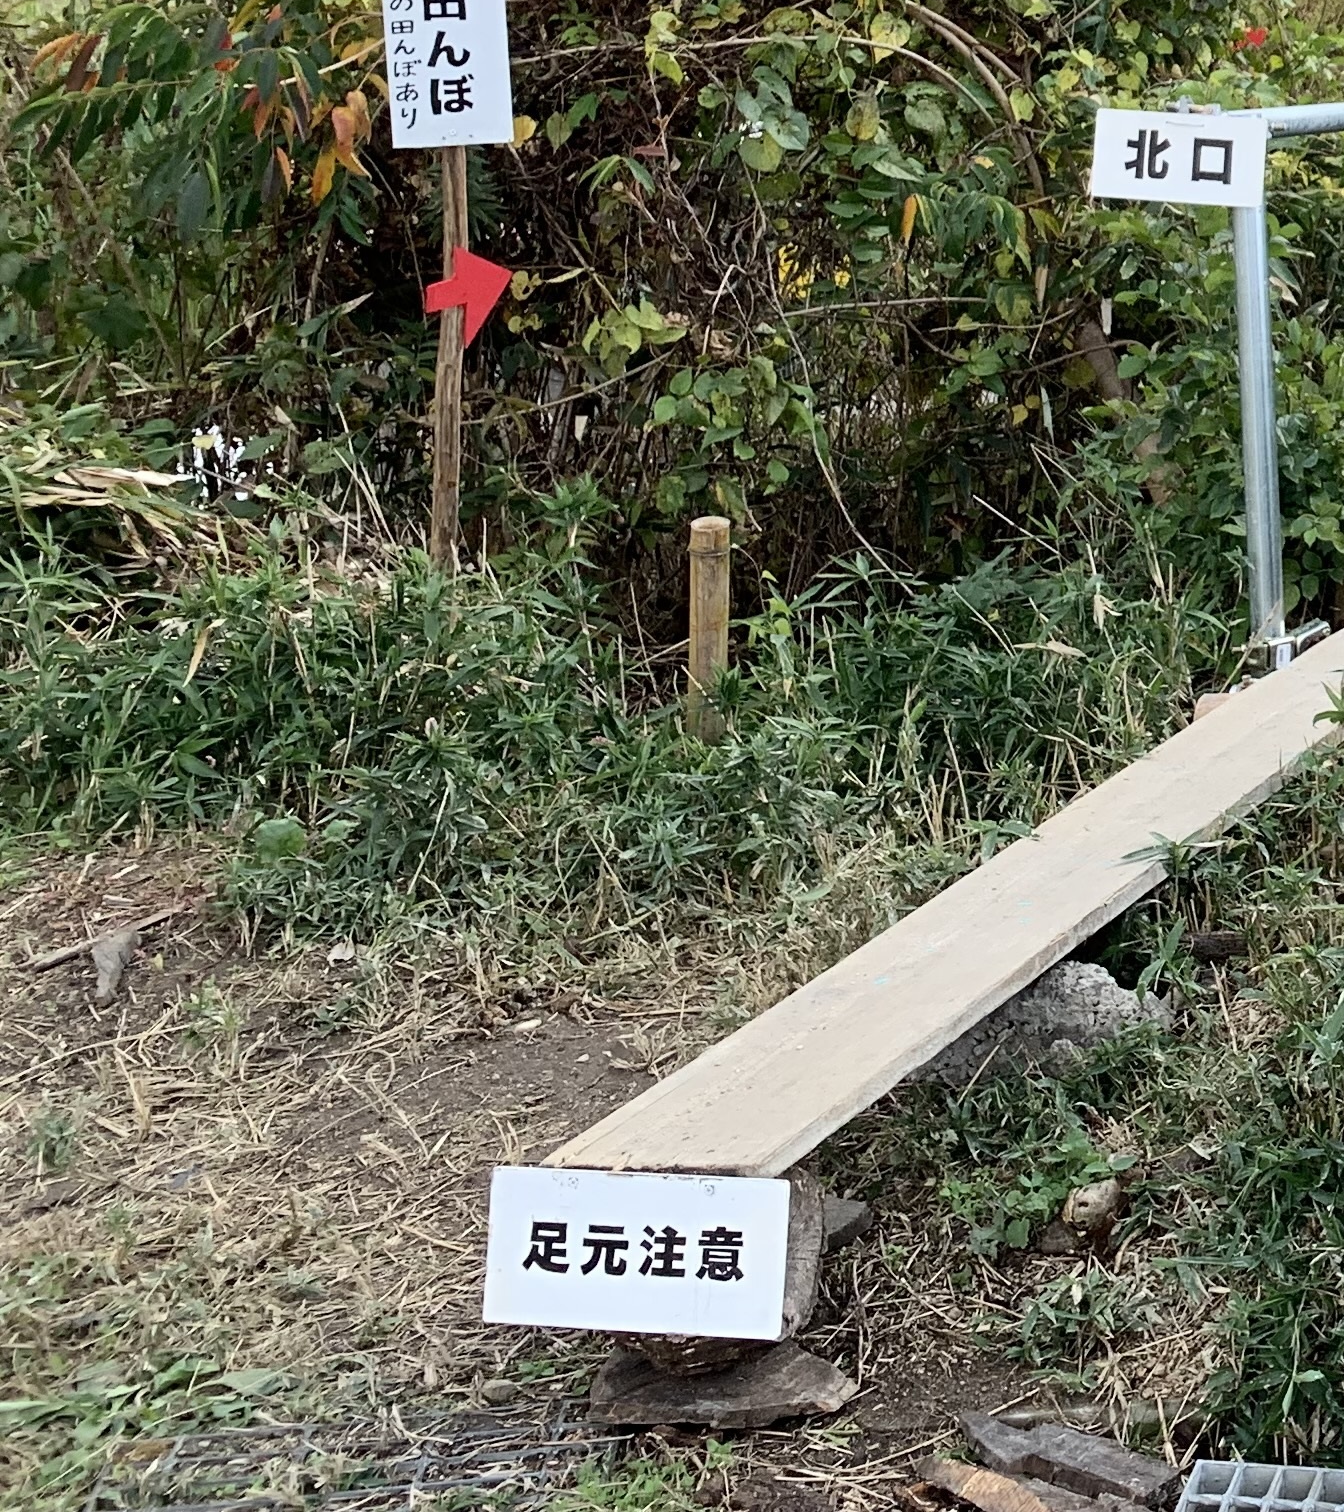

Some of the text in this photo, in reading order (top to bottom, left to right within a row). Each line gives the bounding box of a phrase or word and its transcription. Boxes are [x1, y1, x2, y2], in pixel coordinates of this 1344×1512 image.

[1125, 129, 1234, 185] 北口
[522, 1221, 744, 1281] 足元注意
